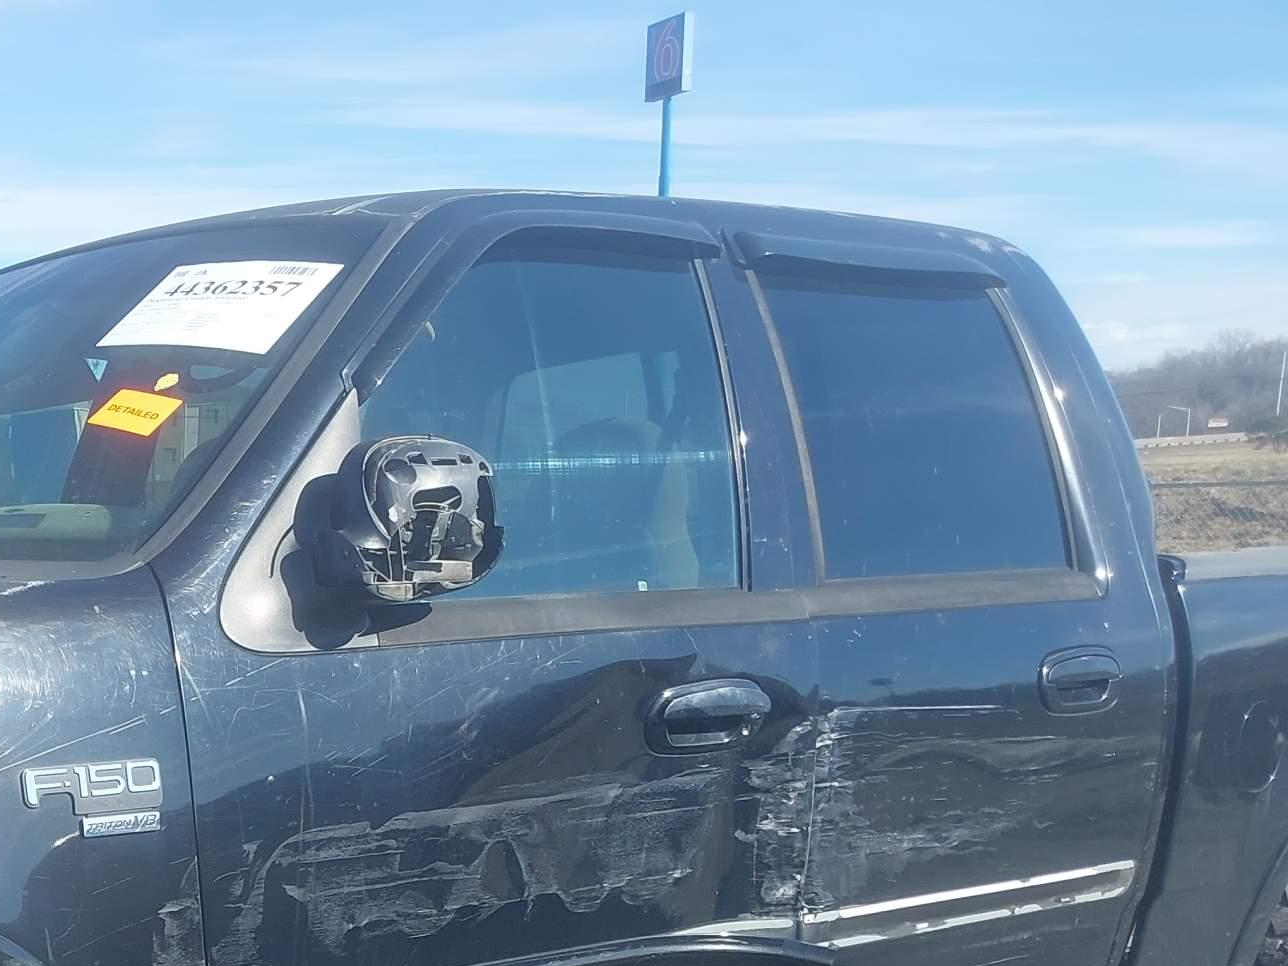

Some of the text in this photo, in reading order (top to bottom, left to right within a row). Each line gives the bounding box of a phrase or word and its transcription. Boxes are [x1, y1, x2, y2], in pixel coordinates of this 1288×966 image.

[164, 279, 303, 297] 44362357
[107, 403, 159, 420] DETAILED
[87, 819, 132, 831] TRITON
